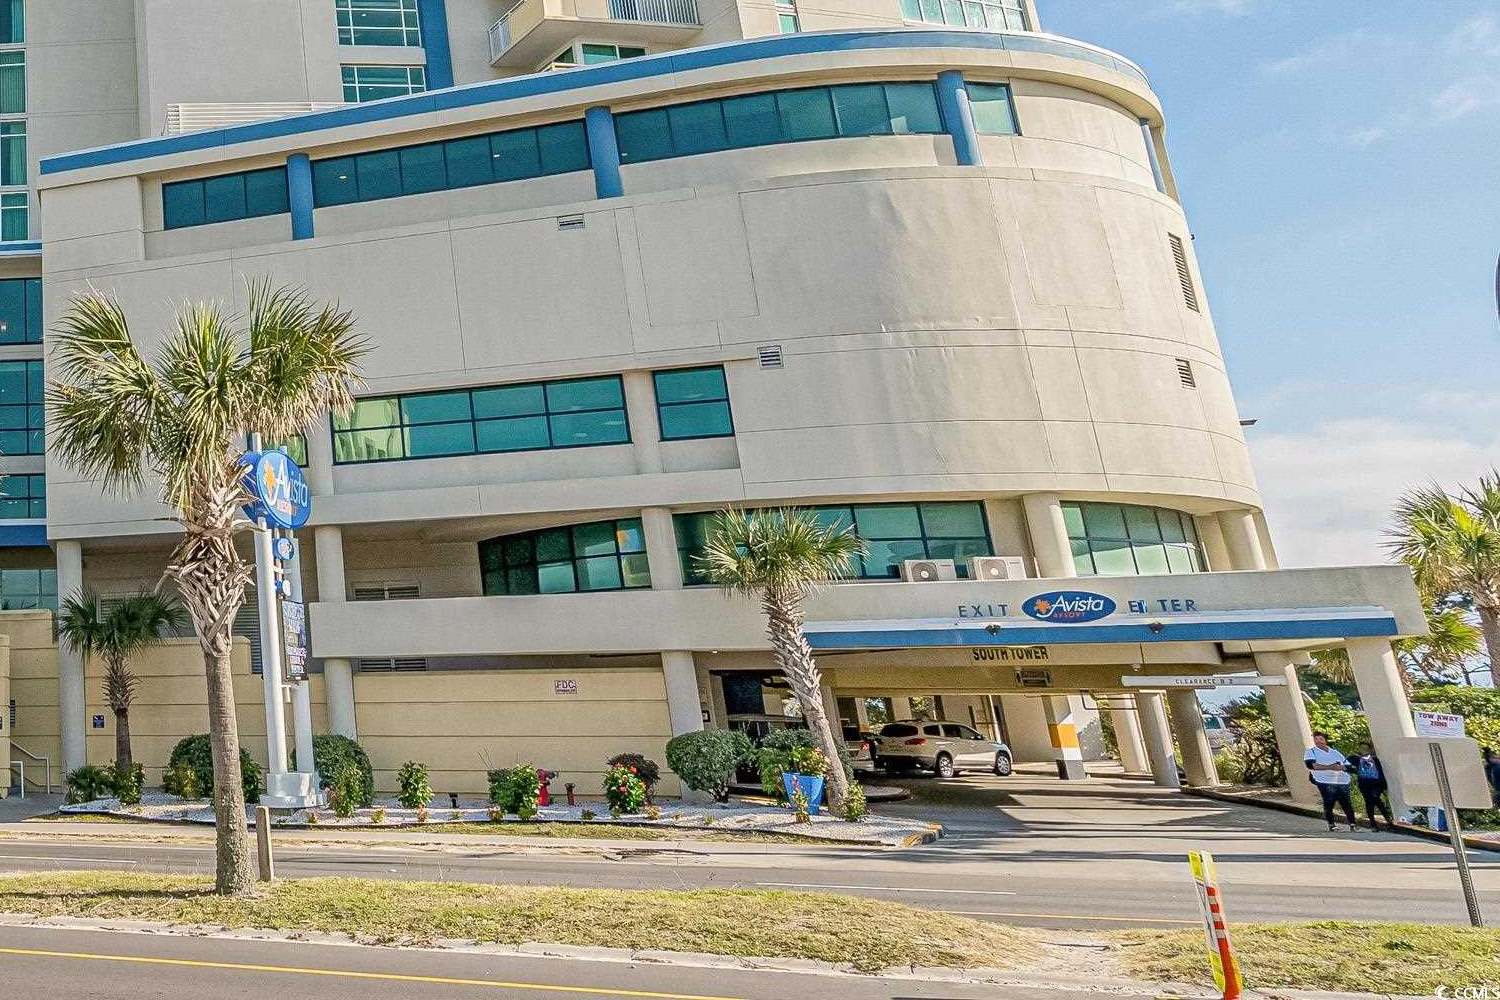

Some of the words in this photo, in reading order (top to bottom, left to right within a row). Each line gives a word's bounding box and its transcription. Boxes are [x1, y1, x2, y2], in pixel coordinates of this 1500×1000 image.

[958, 604, 1008, 618] EXIT
[1037, 595, 1104, 617] Avista
[972, 647, 1009, 660] SOUTH
[1010, 646, 1049, 660] TOWER
[556, 680, 576, 689] FDC
[1418, 712, 1435, 720] TOW
